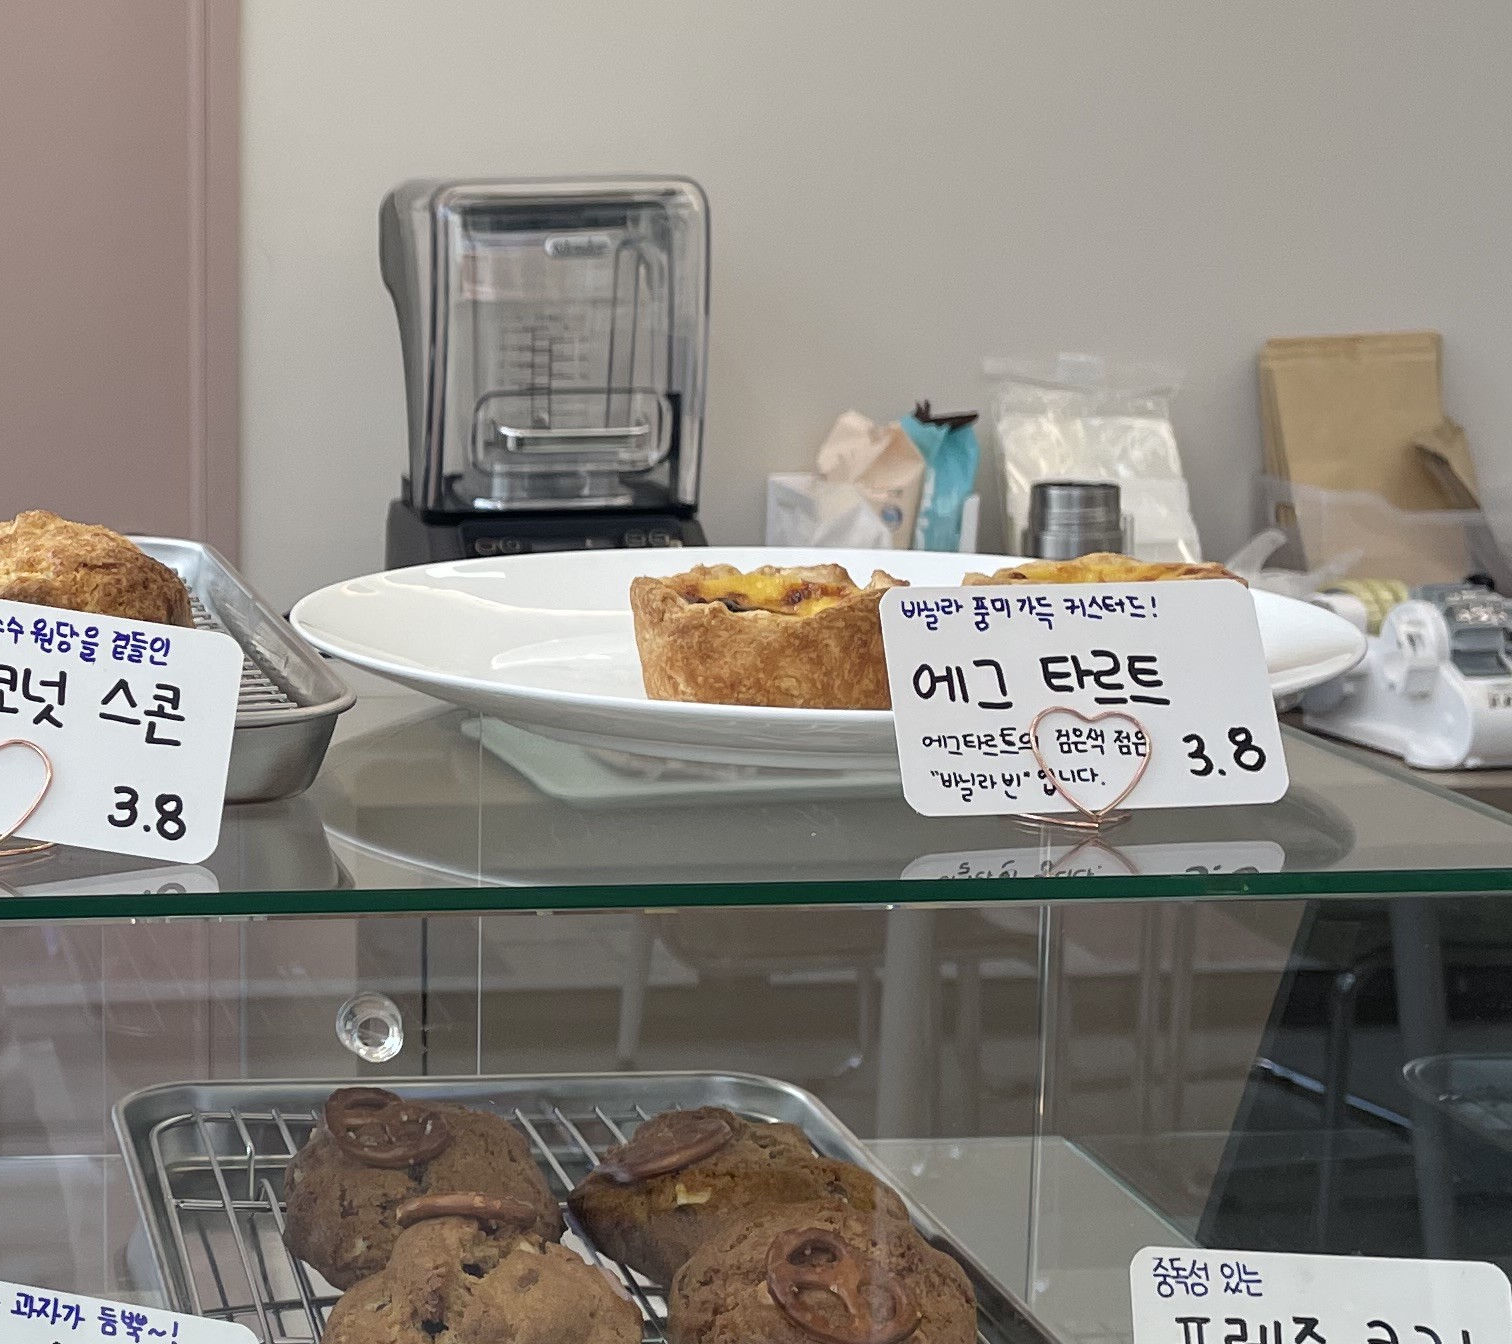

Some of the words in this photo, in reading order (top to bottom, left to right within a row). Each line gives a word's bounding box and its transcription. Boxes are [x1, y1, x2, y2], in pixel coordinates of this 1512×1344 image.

[901, 599, 963, 631] 바닐라
[972, 597, 1011, 632] 풍미
[1016, 596, 1054, 630] 가득
[1063, 596, 1157, 619] 커스터드!
[30, 618, 99, 663] 원당을
[112, 631, 170, 666] 곁들인
[913, 659, 1013, 709] 에그
[1039, 650, 1170, 705] 타르트
[99, 679, 185, 746] 스콘
[1055, 728, 1105, 755] 검은색
[1114, 729, 1147, 757] 점은
[1182, 727, 1266, 776] 3.8
[931, 771, 997, 802] "바닐라
[108, 786, 186, 841] 3.8
[1153, 1258, 1209, 1298] 중독성
[1221, 1262, 1262, 1297] 있는
[11, 1293, 85, 1330] 과자가
